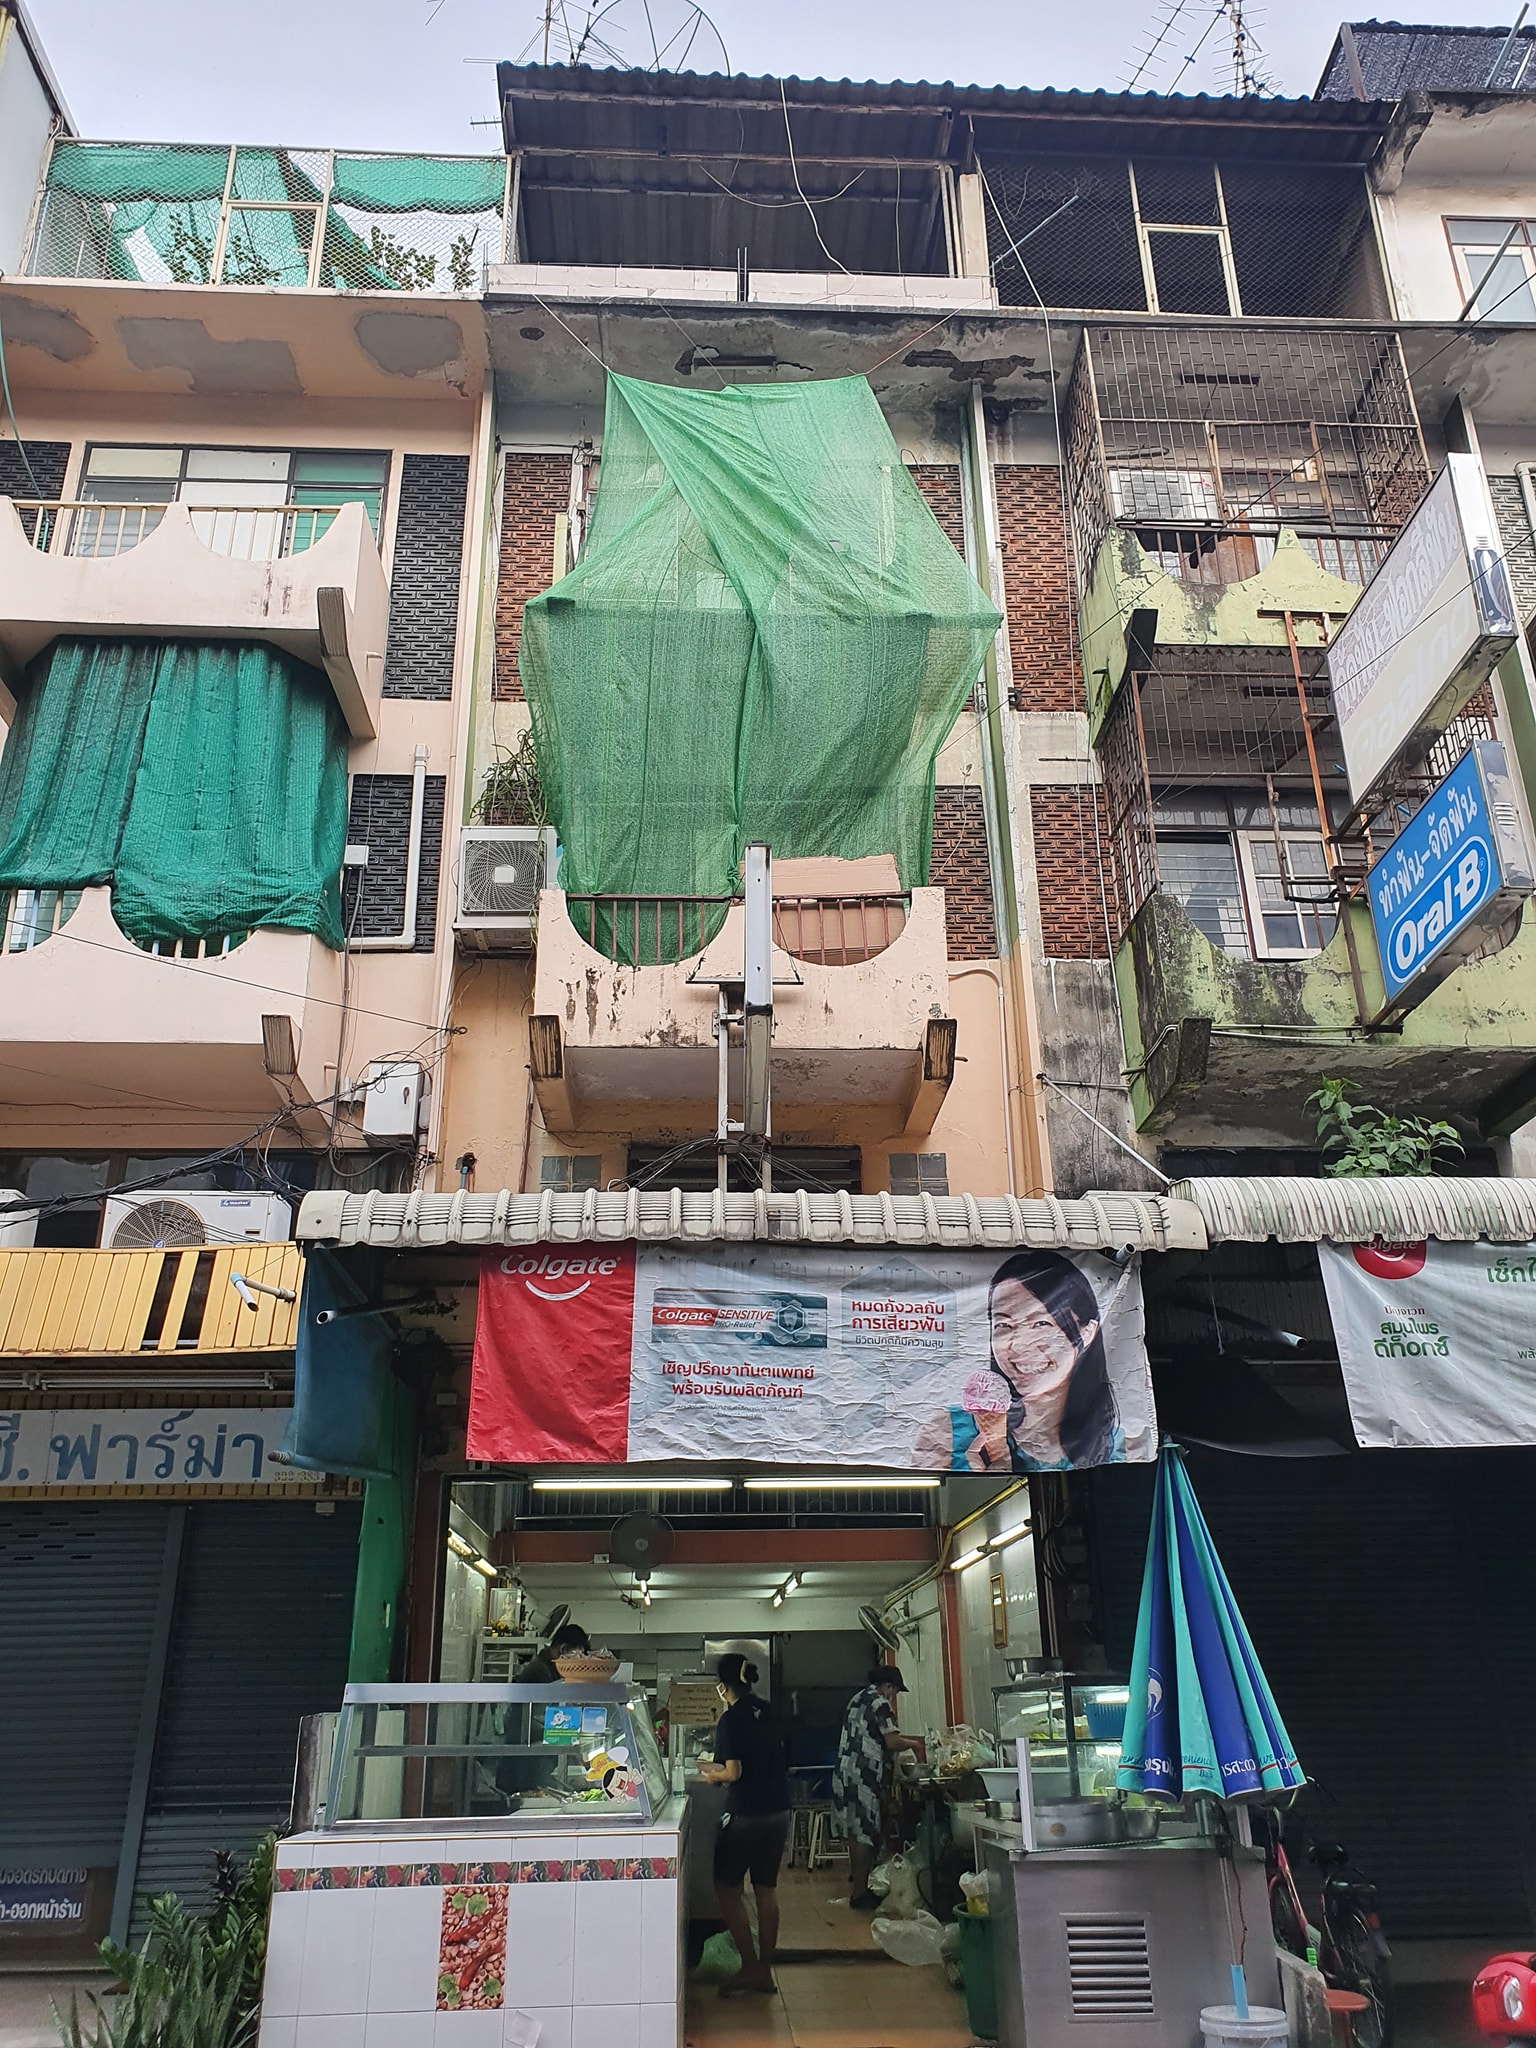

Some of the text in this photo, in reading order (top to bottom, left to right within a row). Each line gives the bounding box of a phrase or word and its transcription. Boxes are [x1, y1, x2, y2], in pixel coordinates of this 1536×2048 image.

[1378, 785, 1479, 918] ทำฟัน-จัดฟัน
[499, 1253, 618, 1280] Colgate
[656, 1308, 775, 1322] Colgate SENSITIVE
[851, 1299, 945, 1315] หมดกังวลกับ
[852, 1314, 945, 1332] การเสียวฟัน
[1380, 1317, 1440, 1338] สมุนไพร
[1373, 1335, 1451, 1358] ดีท็อกซ์
[1517, 1347, 1536, 1360] พลั
[661, 1360, 815, 1380] เชิญปรึกษาทันตแพทย์
[671, 1379, 804, 1398] พร้อมรับผลิตภัณฑ์
[49, 1410, 265, 1480] ฟาร์ม่า
